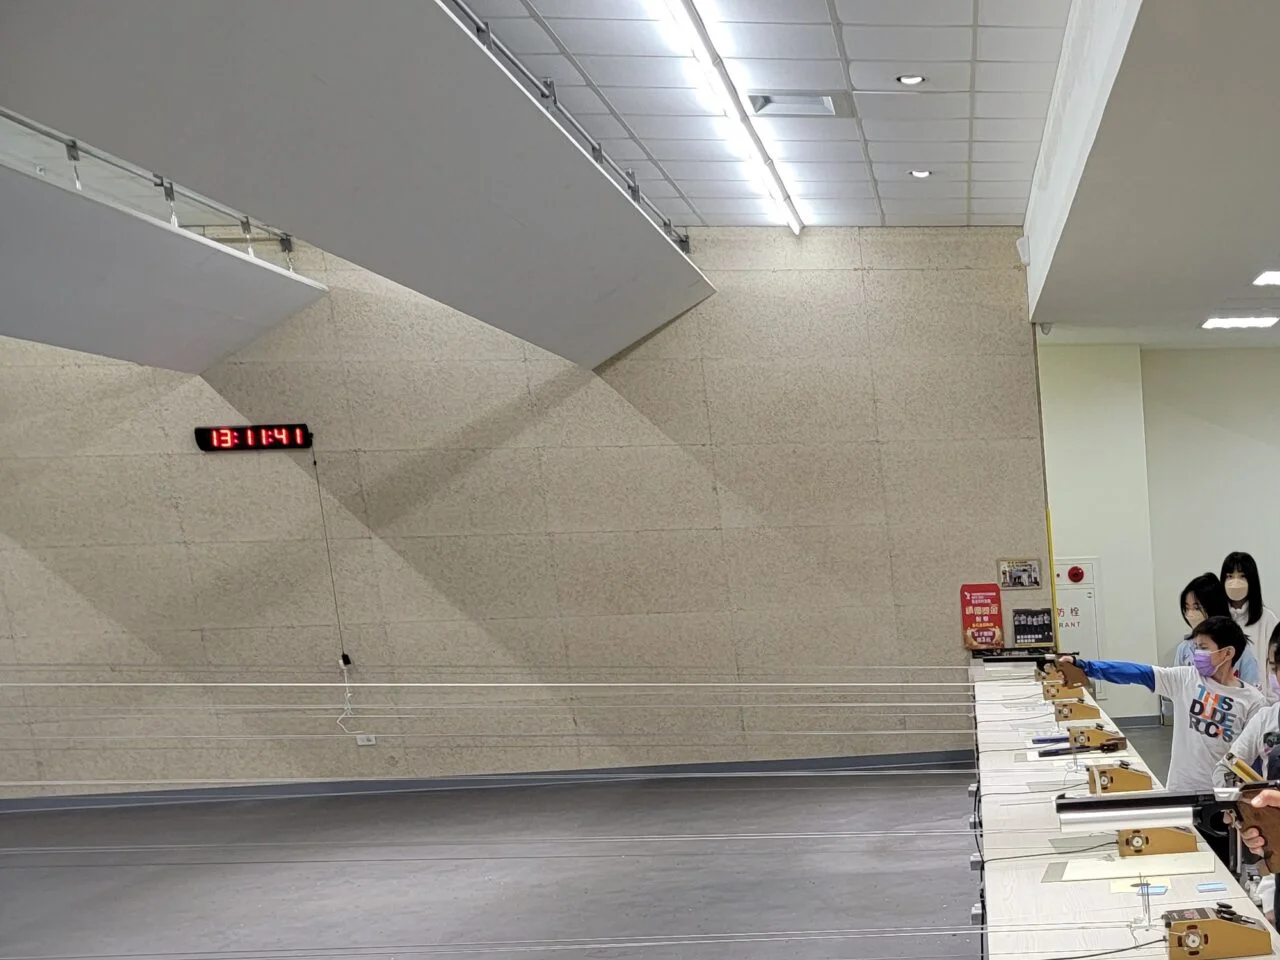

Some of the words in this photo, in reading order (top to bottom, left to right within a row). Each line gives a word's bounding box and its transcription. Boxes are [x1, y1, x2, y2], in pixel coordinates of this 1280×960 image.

[212, 428, 304, 447] 13:11:41
[1057, 606, 1080, 618] 防栓
[1197, 684, 1235, 712] THIS
[1189, 698, 1237, 728] DUDE
